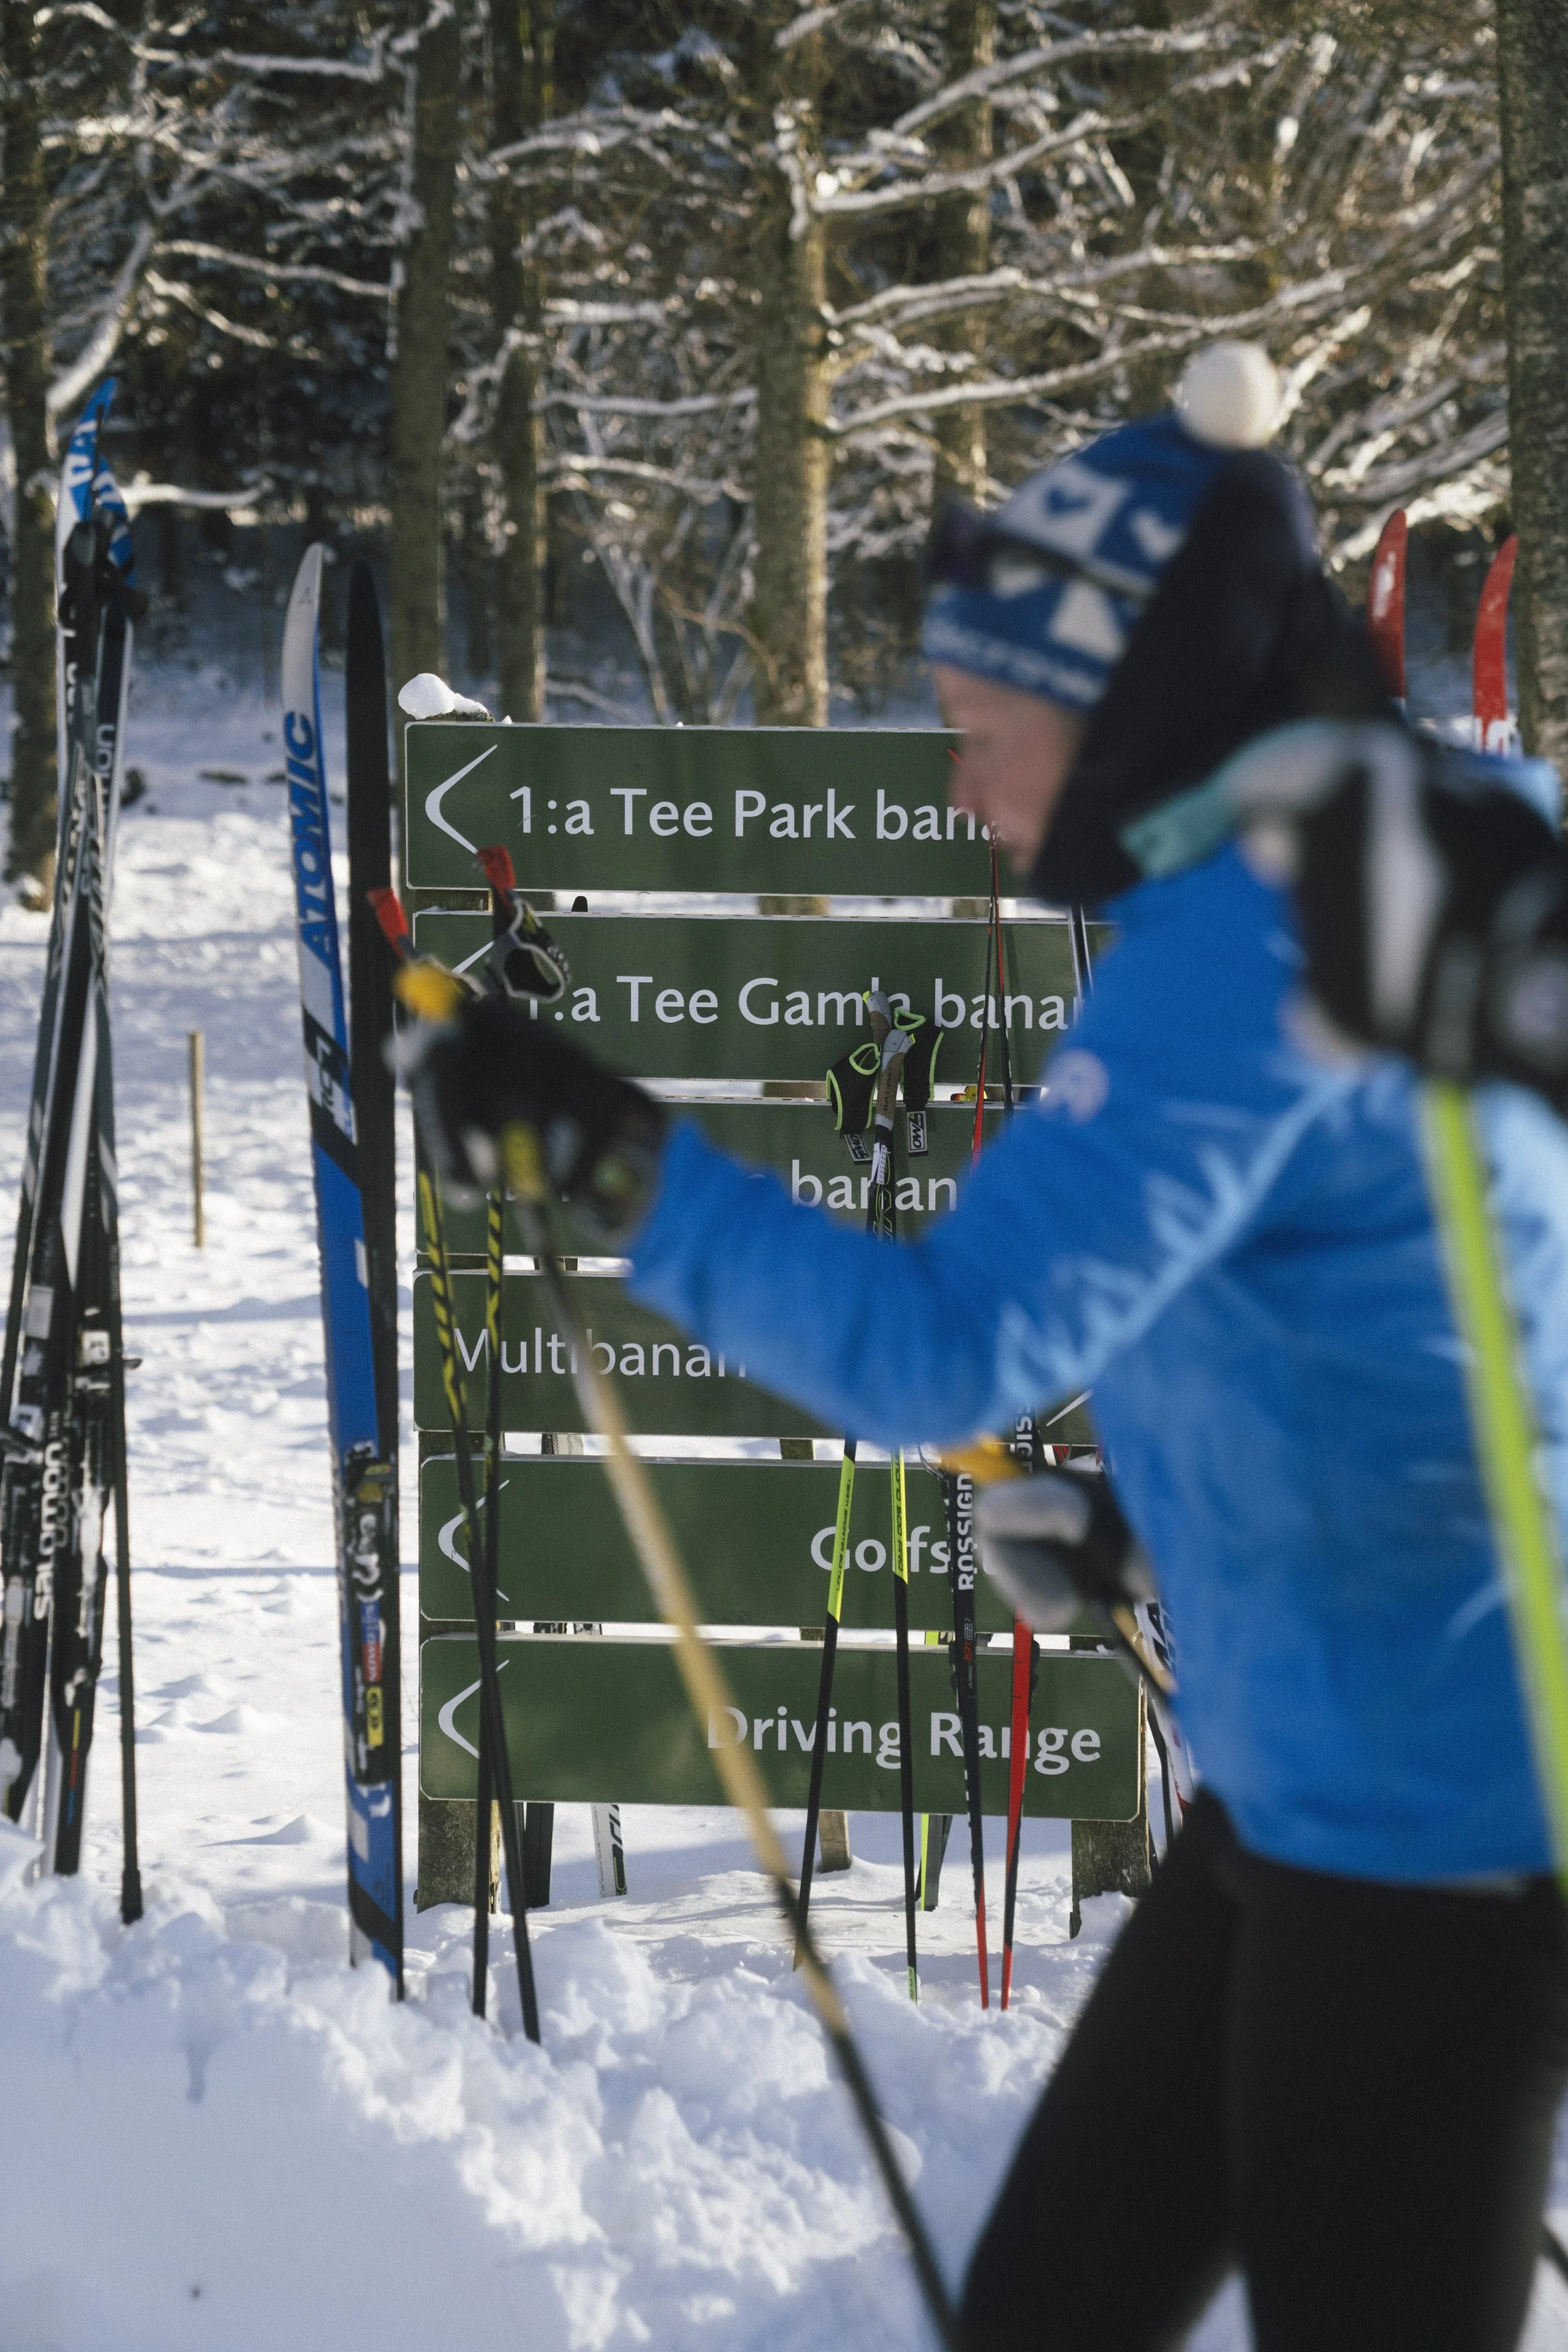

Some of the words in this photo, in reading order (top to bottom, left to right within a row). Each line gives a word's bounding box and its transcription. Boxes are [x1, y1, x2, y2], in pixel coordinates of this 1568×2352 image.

[285, 712, 334, 970] ATOMIC
[509, 786, 595, 835] 1:a
[610, 788, 713, 837] Tee
[735, 788, 856, 839] Park
[616, 975, 718, 1024] Tee
[935, 978, 1078, 1030] bana
[707, 1705, 901, 1770] Driving
[931, 1712, 1101, 1775] Range
